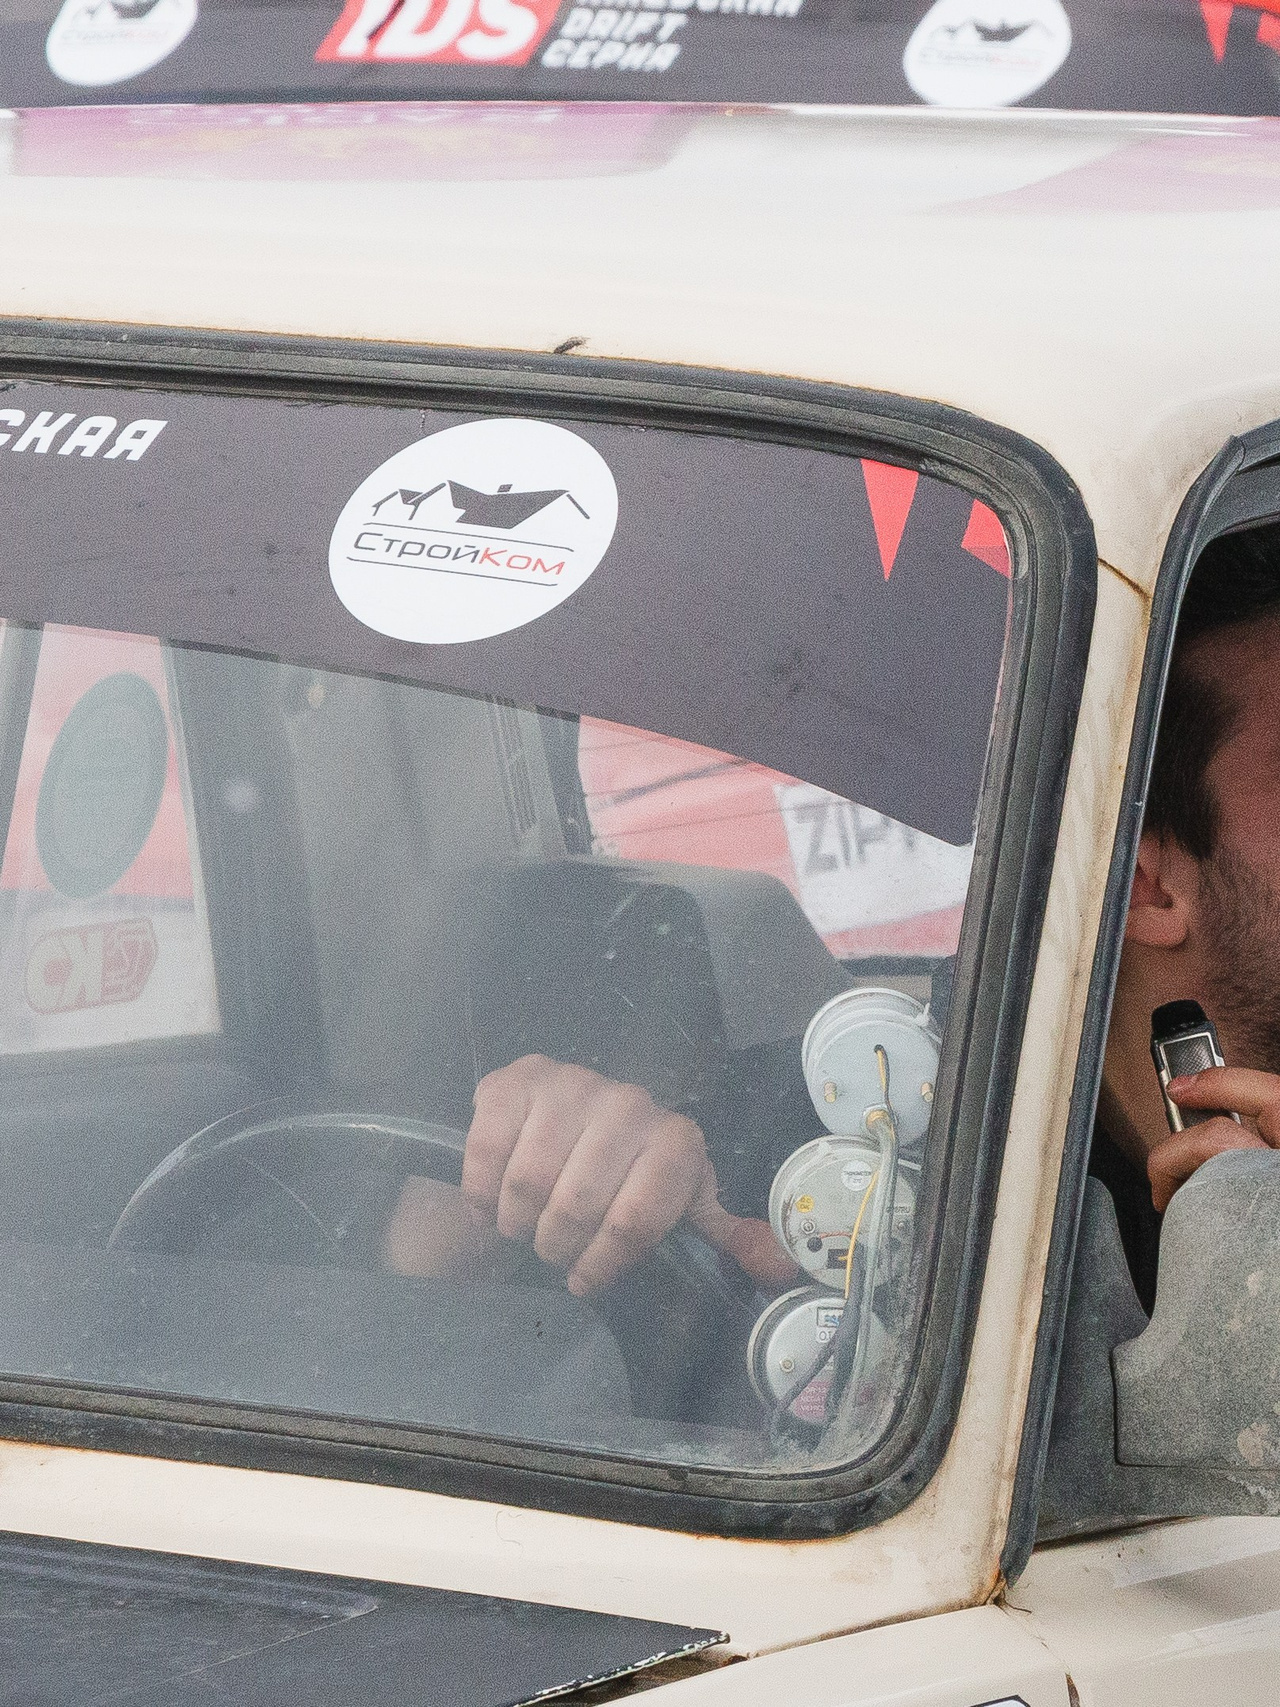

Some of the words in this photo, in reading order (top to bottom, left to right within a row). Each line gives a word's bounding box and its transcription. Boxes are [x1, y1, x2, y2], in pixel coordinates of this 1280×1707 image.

[336, 0, 539, 60] IDS
[560, 8, 688, 42] DRIFT
[540, 38, 682, 72] СЕРИЯ
[794, 800, 920, 876] ZIP
